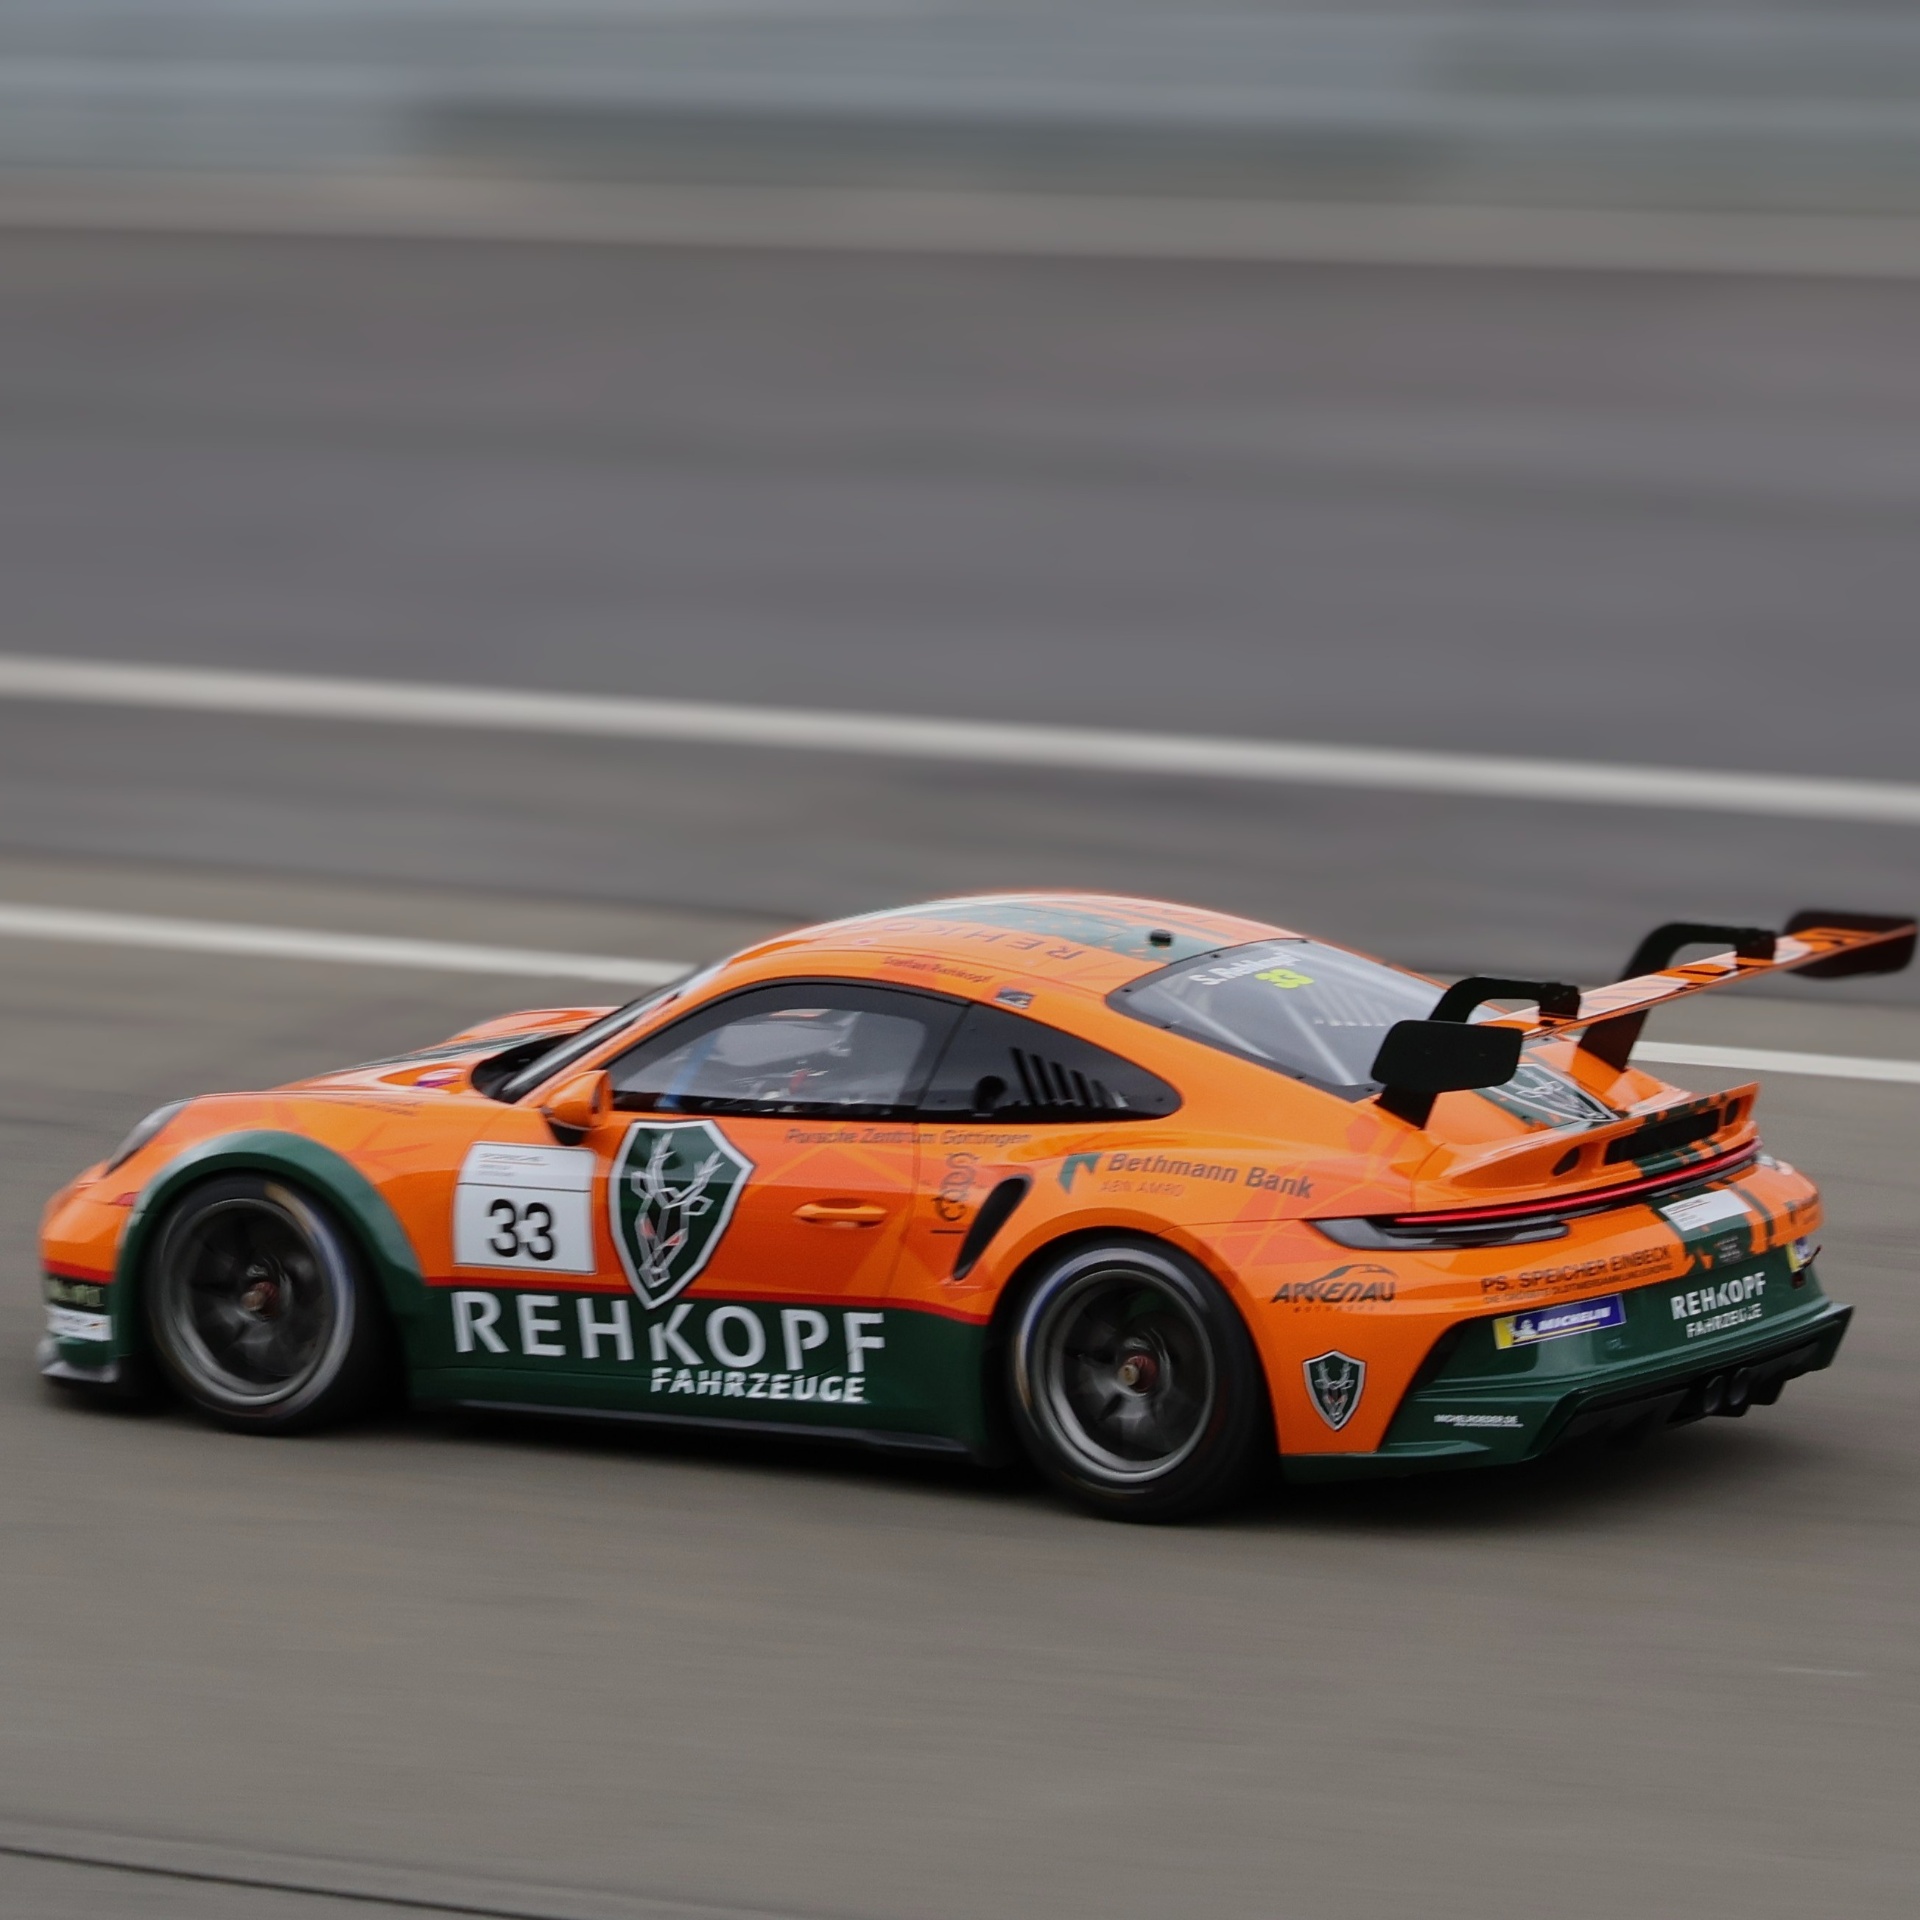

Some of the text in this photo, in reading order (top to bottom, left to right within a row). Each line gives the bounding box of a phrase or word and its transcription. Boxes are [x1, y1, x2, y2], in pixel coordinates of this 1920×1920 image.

[1107, 1152, 1316, 1200] Bethmann Bank
[486, 1199, 555, 1261] 33
[1670, 1271, 1767, 1321] REHKOPF
[450, 1291, 886, 1374] REHKOPF
[650, 1367, 867, 1404] FAHRZEUGE
